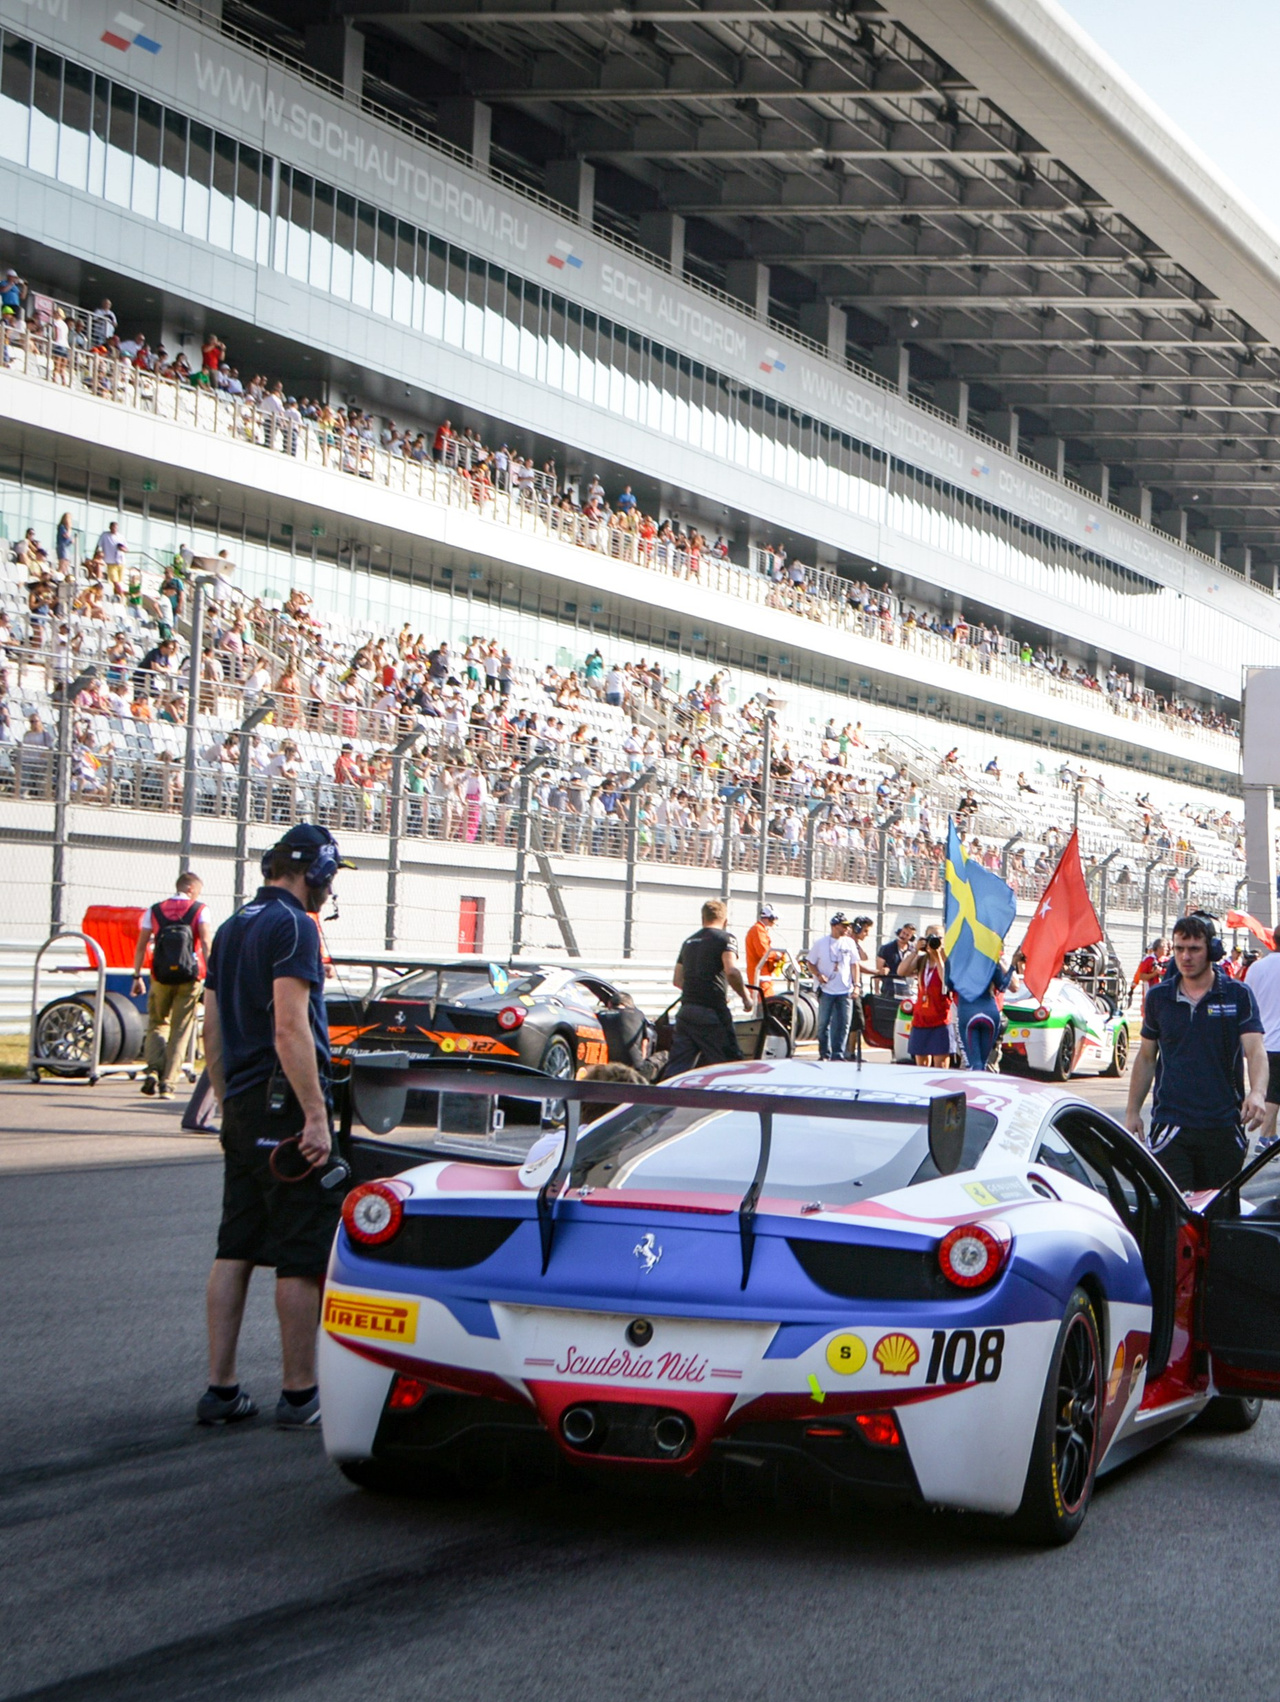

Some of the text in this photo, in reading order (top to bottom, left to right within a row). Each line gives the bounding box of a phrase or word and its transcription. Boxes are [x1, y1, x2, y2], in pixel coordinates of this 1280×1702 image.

[194, 52, 529, 252] WWW.SOCHIAUTODROM.RU
[601, 264, 747, 360] SOCHI AUTODROM
[800, 366, 963, 468] WWW.SOCHIAUTODROM.RU
[471, 1041, 497, 1052] 127
[324, 1297, 409, 1335] PIRELLI
[556, 1345, 710, 1384] Scuderia Niki
[840, 1346, 851, 1359] S
[925, 1328, 1006, 1385] 108
